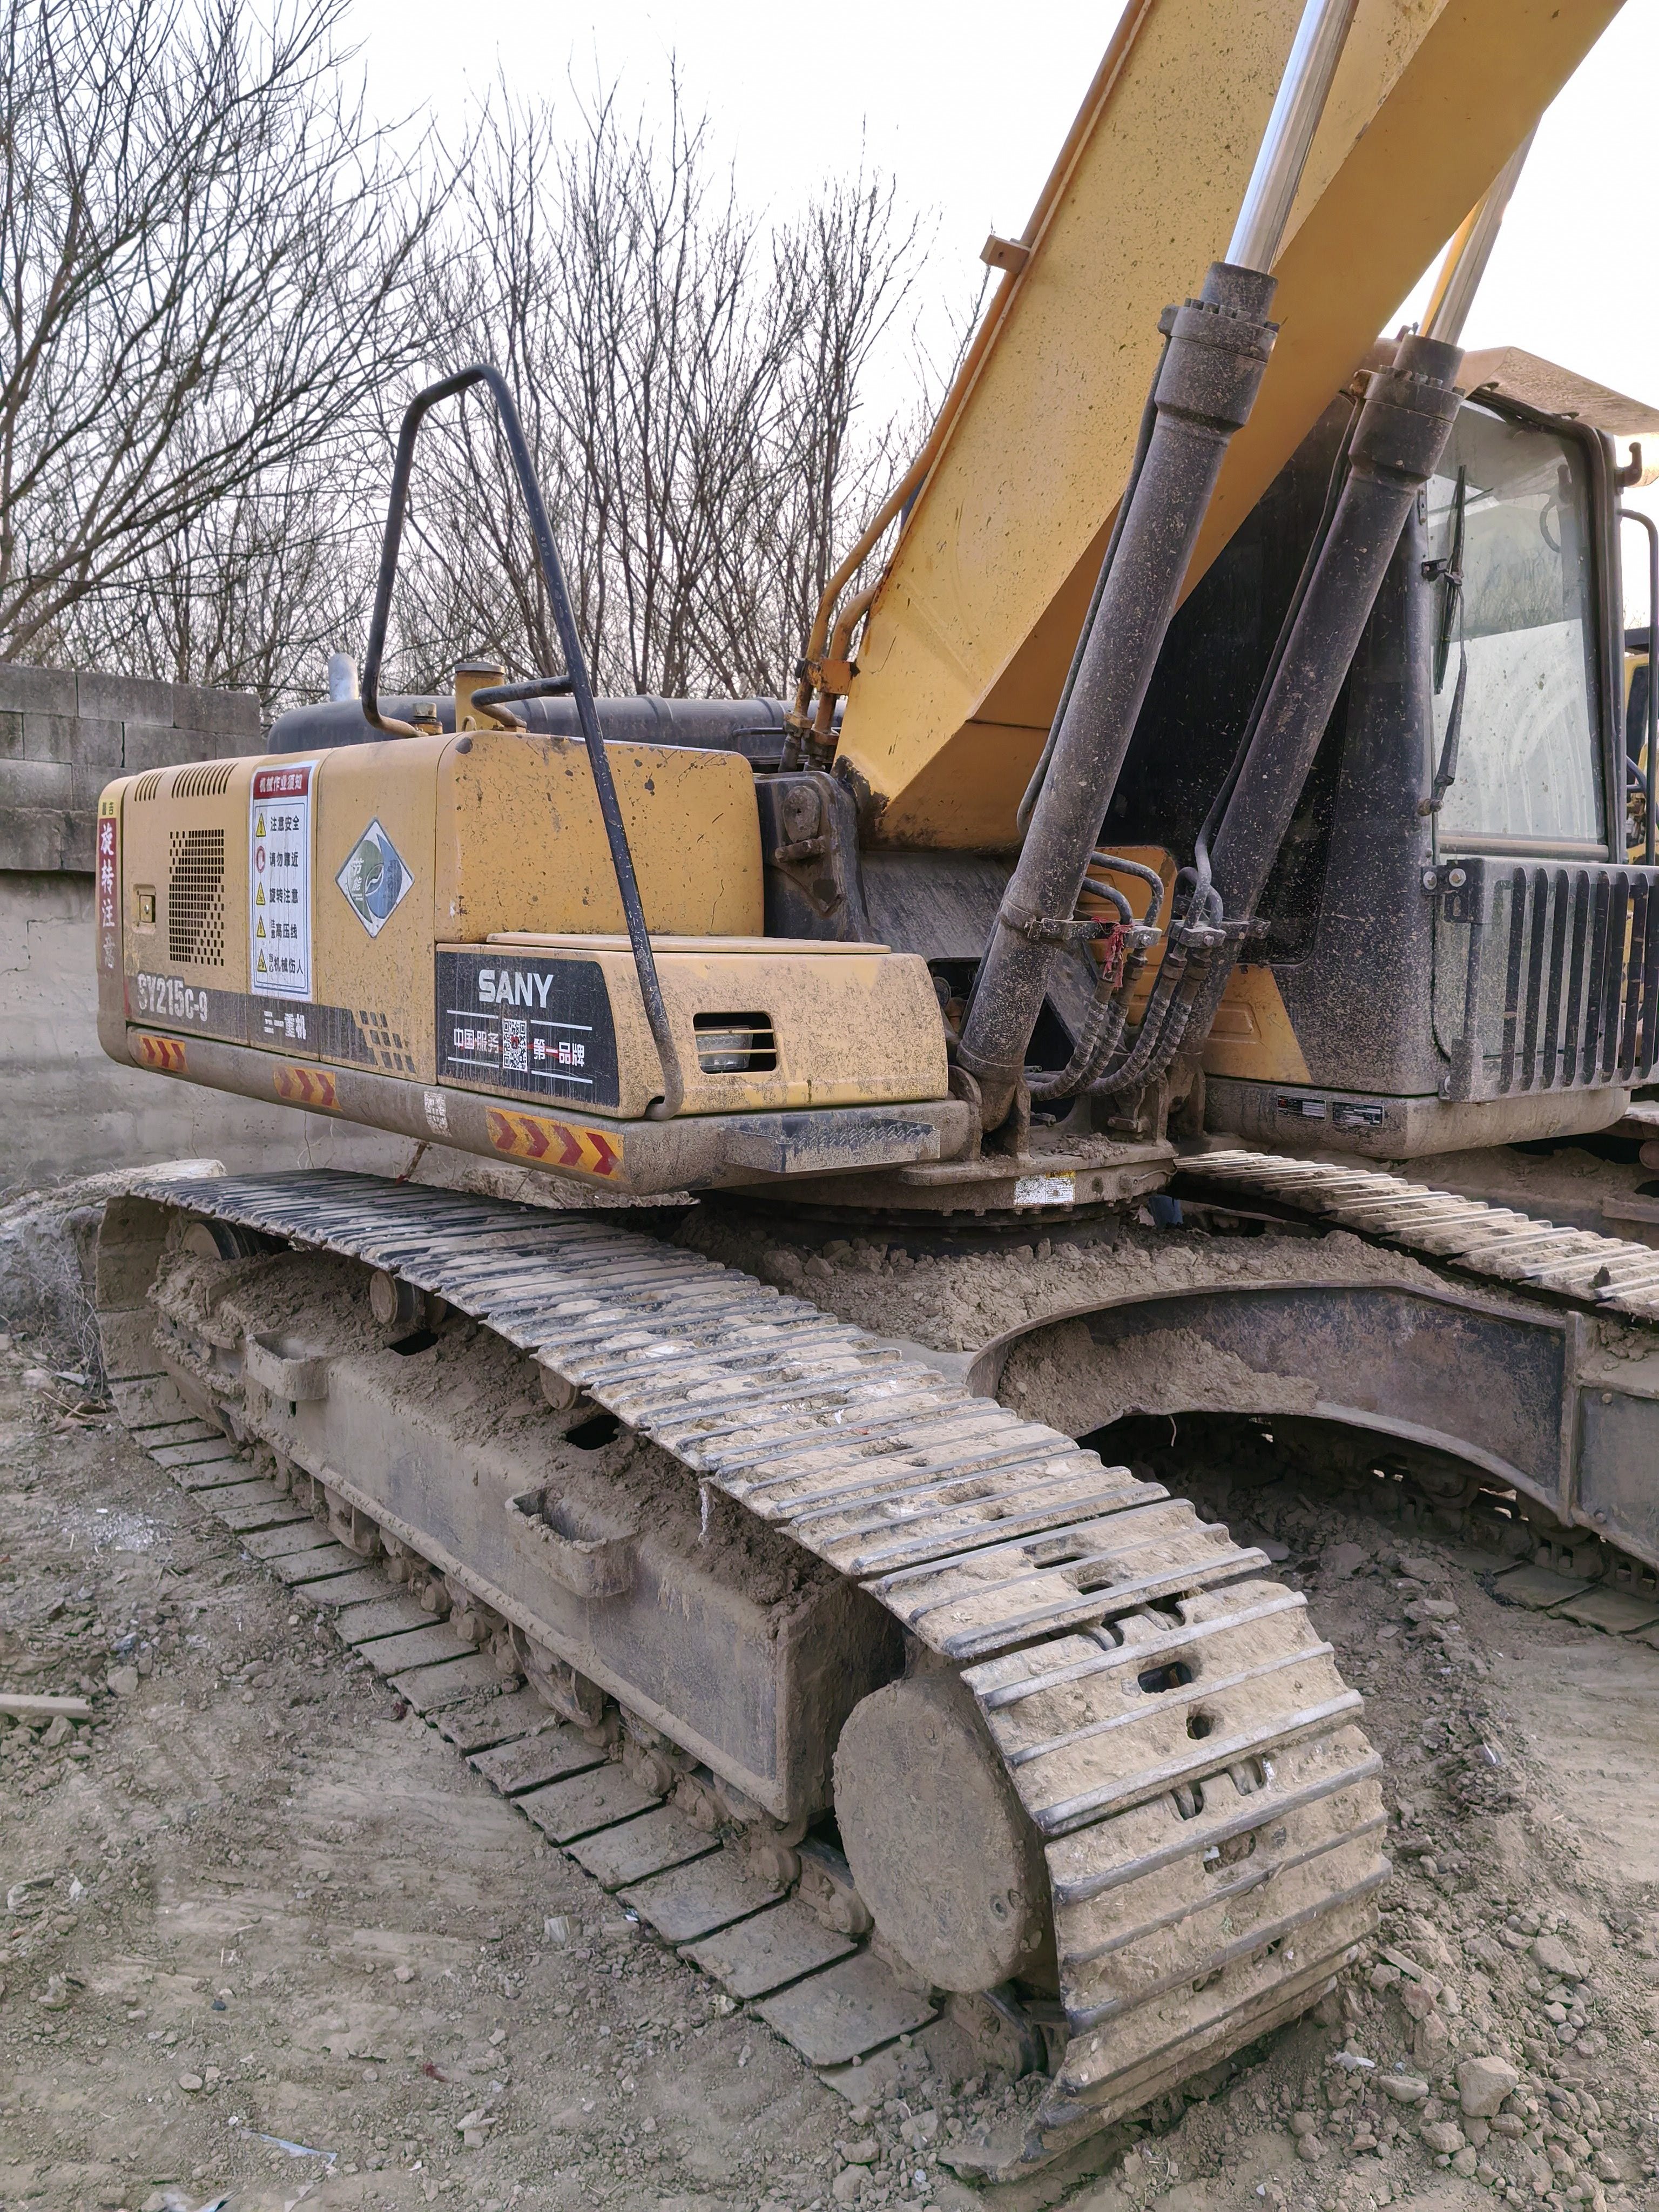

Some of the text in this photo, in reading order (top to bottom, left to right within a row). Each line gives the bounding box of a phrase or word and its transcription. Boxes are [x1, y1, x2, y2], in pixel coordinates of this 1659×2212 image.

[259, 774, 303, 793] 机械作业须知
[271, 815, 300, 831] 注意安全
[269, 852, 299, 867] 请勿靠近
[100, 822, 115, 969] 旋转注意
[269, 887, 299, 903] 旋转注意
[478, 969, 554, 1008] SANY
[264, 1010, 307, 1040] 三一重机
[534, 1037, 585, 1067] 第一品牌
